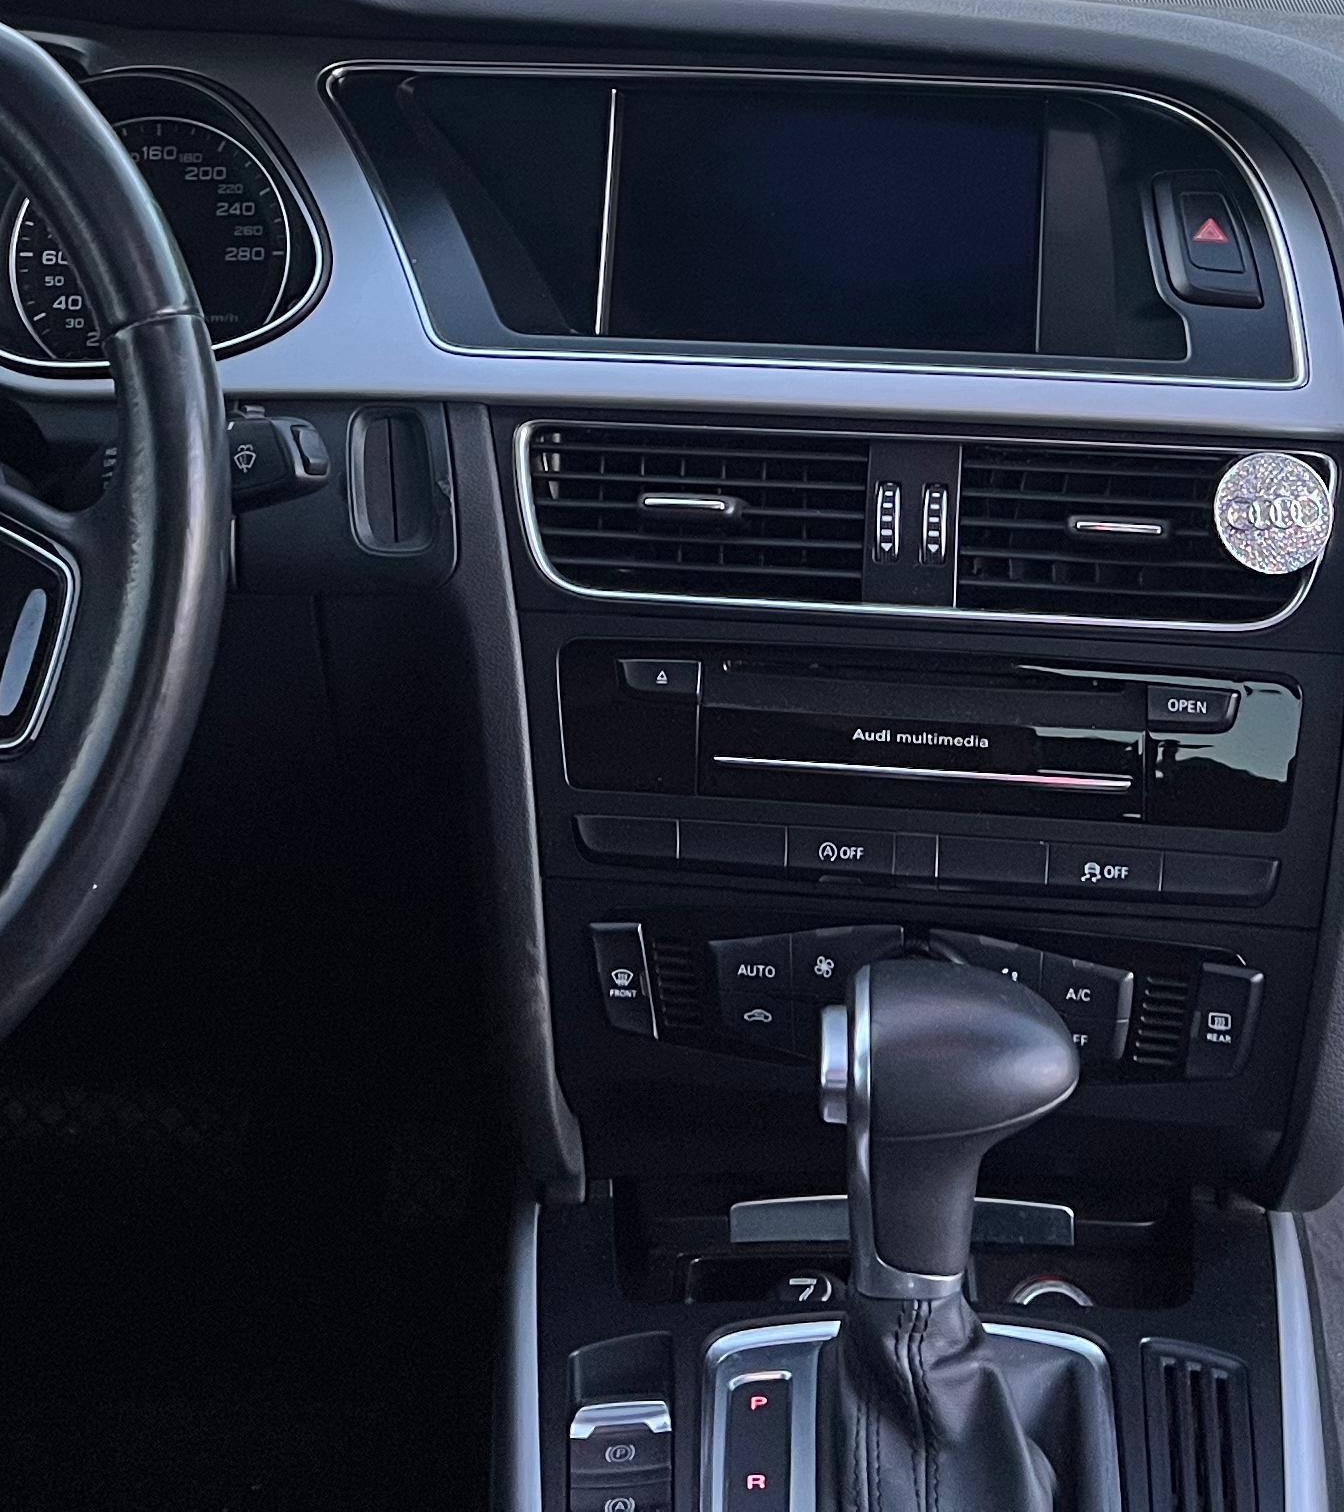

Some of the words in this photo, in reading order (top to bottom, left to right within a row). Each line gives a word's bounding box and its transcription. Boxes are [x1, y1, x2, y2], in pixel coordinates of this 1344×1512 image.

[142, 145, 177, 161] 160
[184, 166, 227, 181] 200
[217, 183, 244, 195] 220
[216, 202, 255, 216] 240
[234, 225, 263, 237] 260
[225, 247, 265, 261] 280
[44, 276, 64, 286] 50
[52, 295, 82, 310] 40
[65, 318, 84, 328] 30
[1167, 698, 1207, 714] OPEN
[852, 728, 891, 742] Audi
[896, 731, 989, 748] multimedia
[839, 846, 864, 860] OFF
[1103, 865, 1129, 879] OFF
[737, 964, 776, 978] AUTO
[609, 989, 637, 999] FRONT
[1065, 988, 1091, 1002] A/C
[1073, 1034, 1089, 1047] FF
[1206, 1033, 1232, 1044] REAR
[750, 1396, 768, 1410] P
[747, 1474, 766, 1490] R
